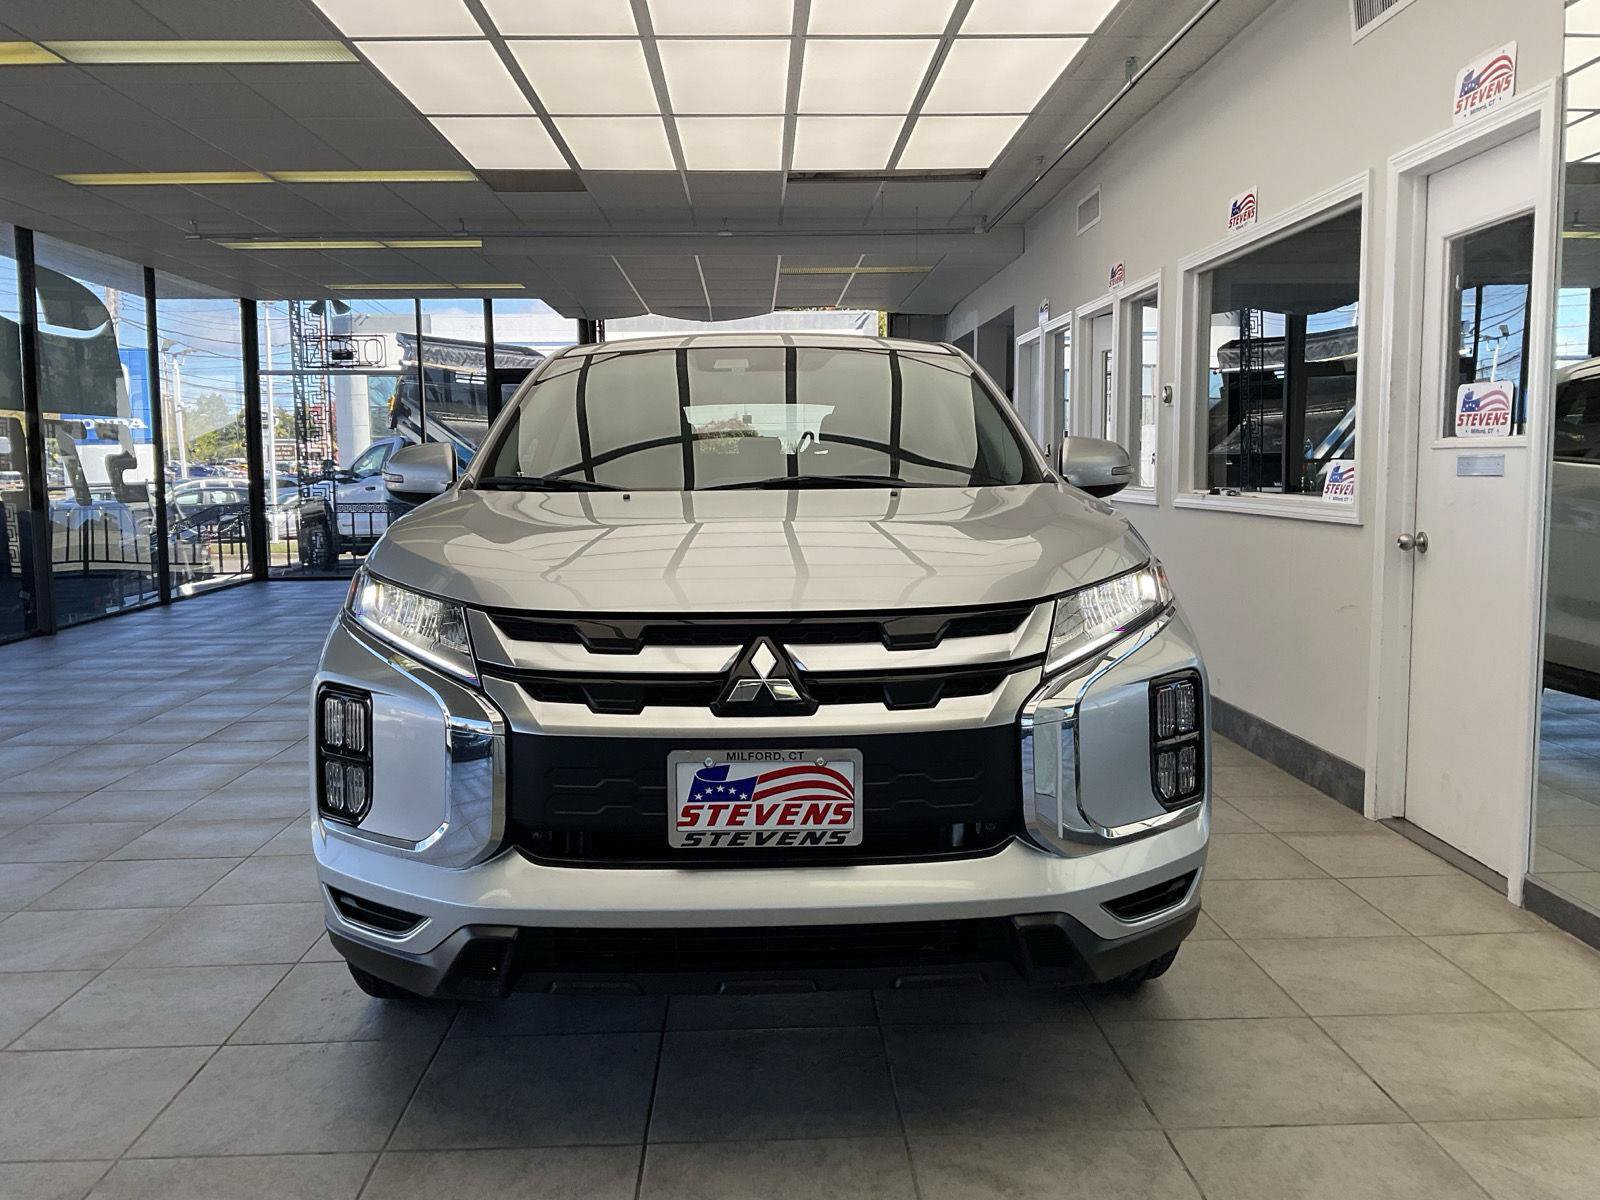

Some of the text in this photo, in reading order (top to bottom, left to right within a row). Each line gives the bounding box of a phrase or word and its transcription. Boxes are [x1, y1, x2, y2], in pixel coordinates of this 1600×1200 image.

[1455, 73, 1513, 115] STEVENS
[1228, 206, 1256, 229] STEVENS
[1457, 412, 1509, 427] STEVENS
[1324, 483, 1354, 496] STEVEN
[726, 751, 804, 762] MILFORD, CT
[677, 802, 854, 827] STEVENS
[681, 830, 851, 847] STEVENS
